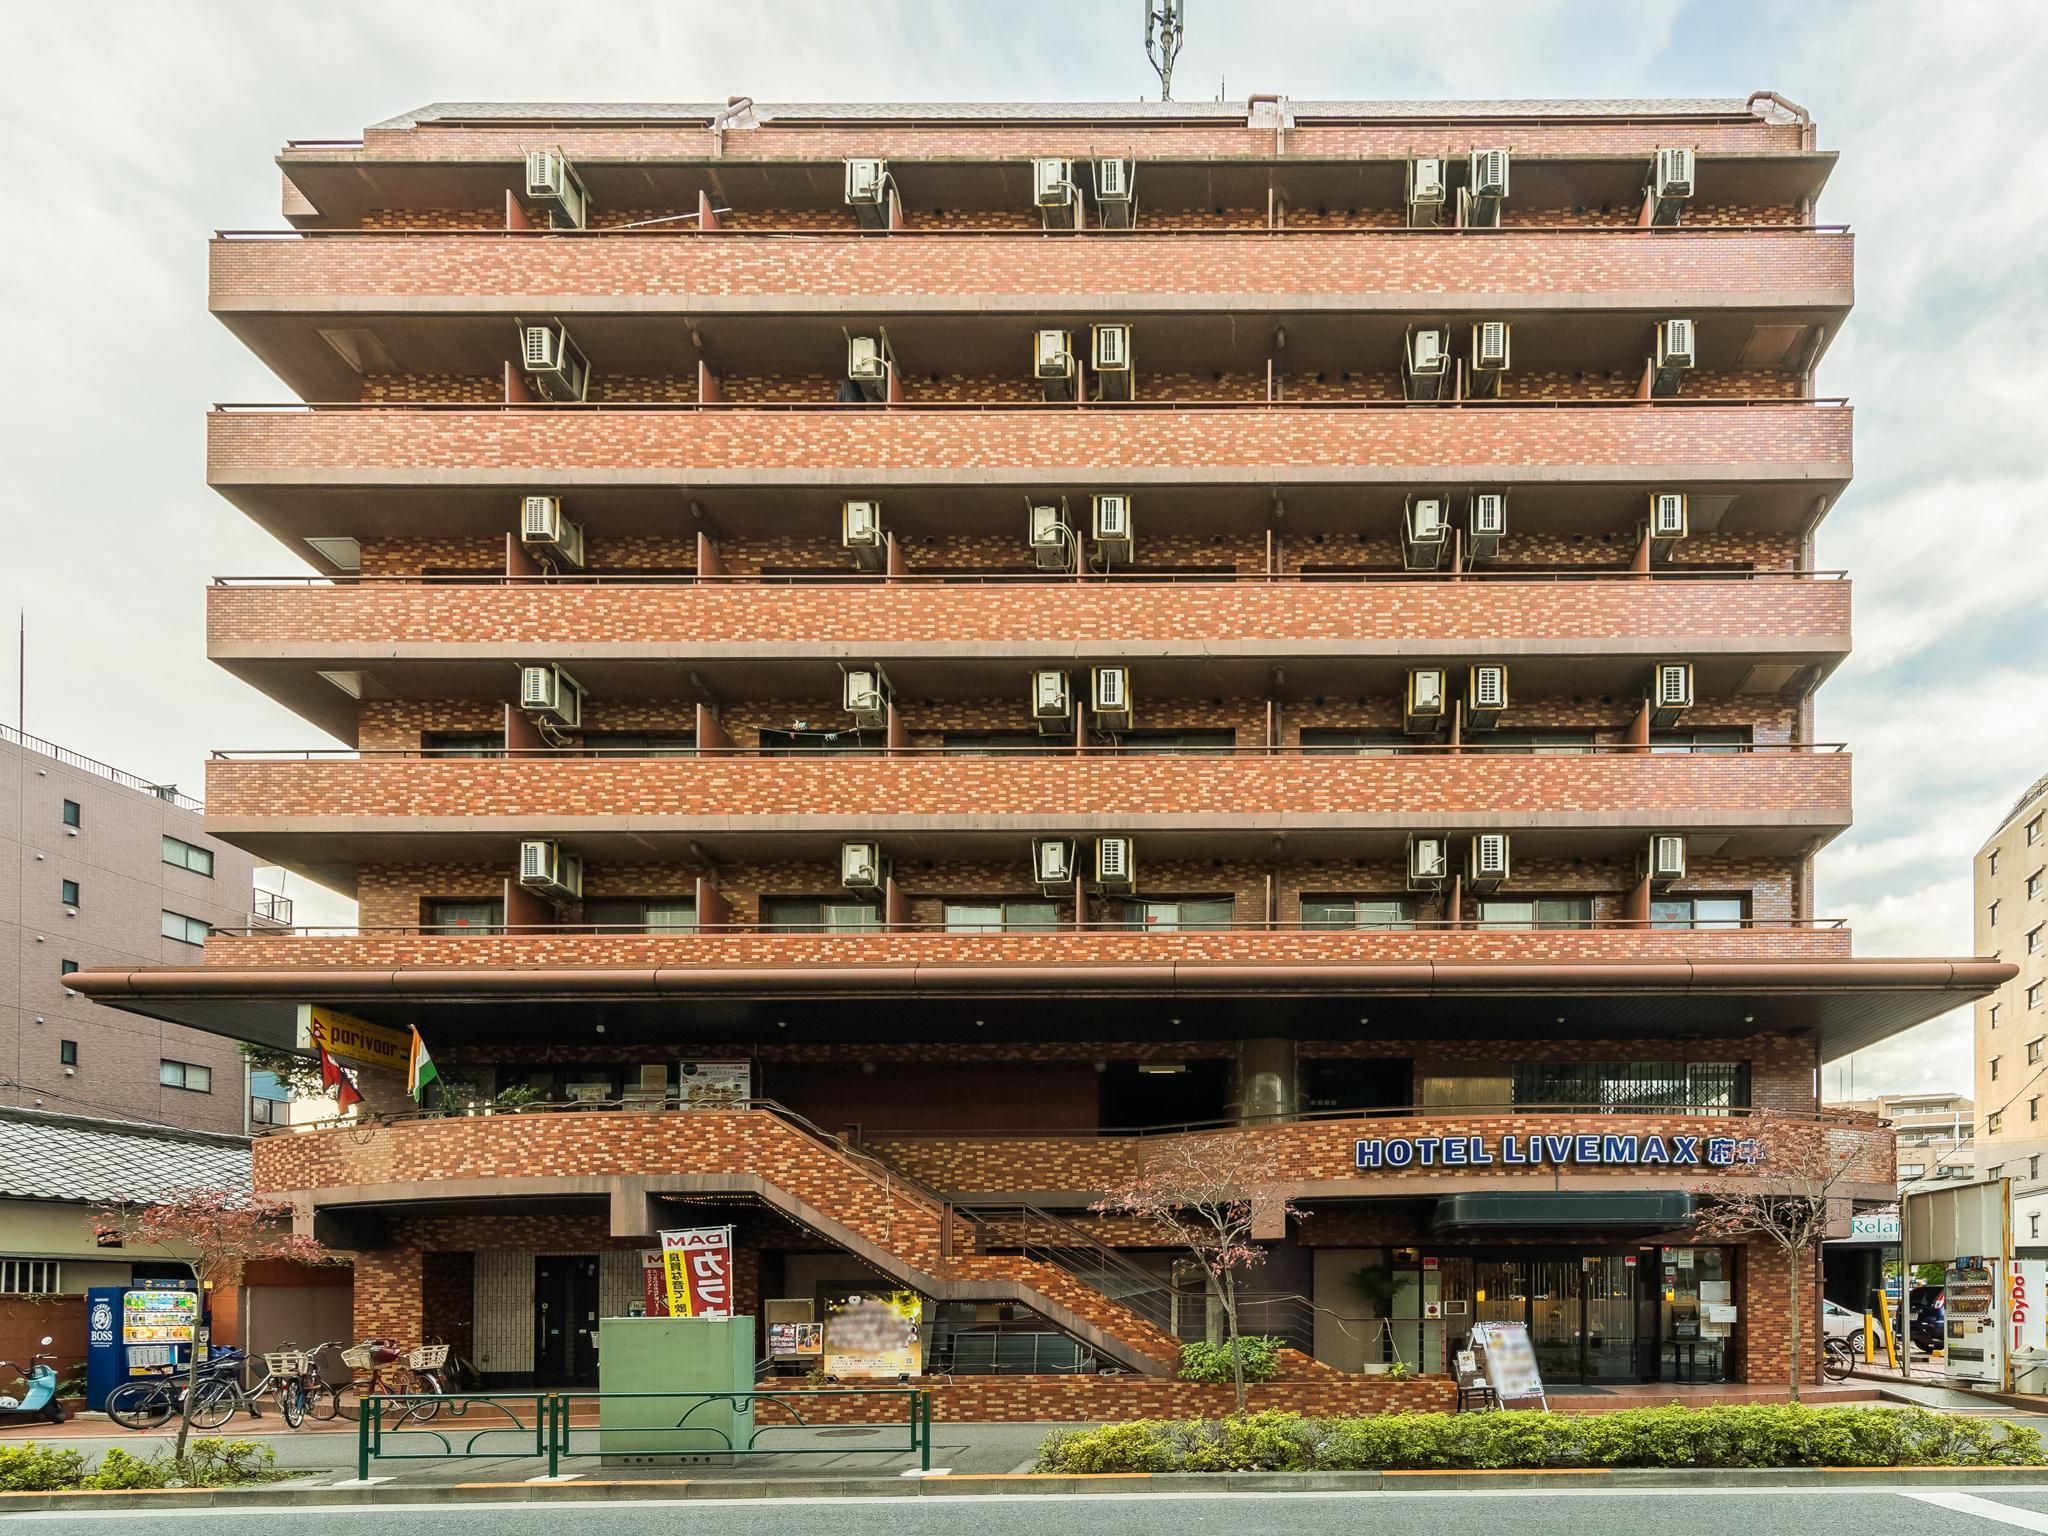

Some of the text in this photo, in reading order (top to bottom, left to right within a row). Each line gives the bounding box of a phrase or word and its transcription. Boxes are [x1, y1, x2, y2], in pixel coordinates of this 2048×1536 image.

[330, 1026, 399, 1057] parivaar
[1355, 1138, 1494, 1168] HOTEL
[1708, 1138, 1767, 1165] 府中
[93, 1303, 111, 1312] COFFEE
[2012, 1276, 2030, 1323] DyDo
[91, 1331, 113, 1341] BOSS
